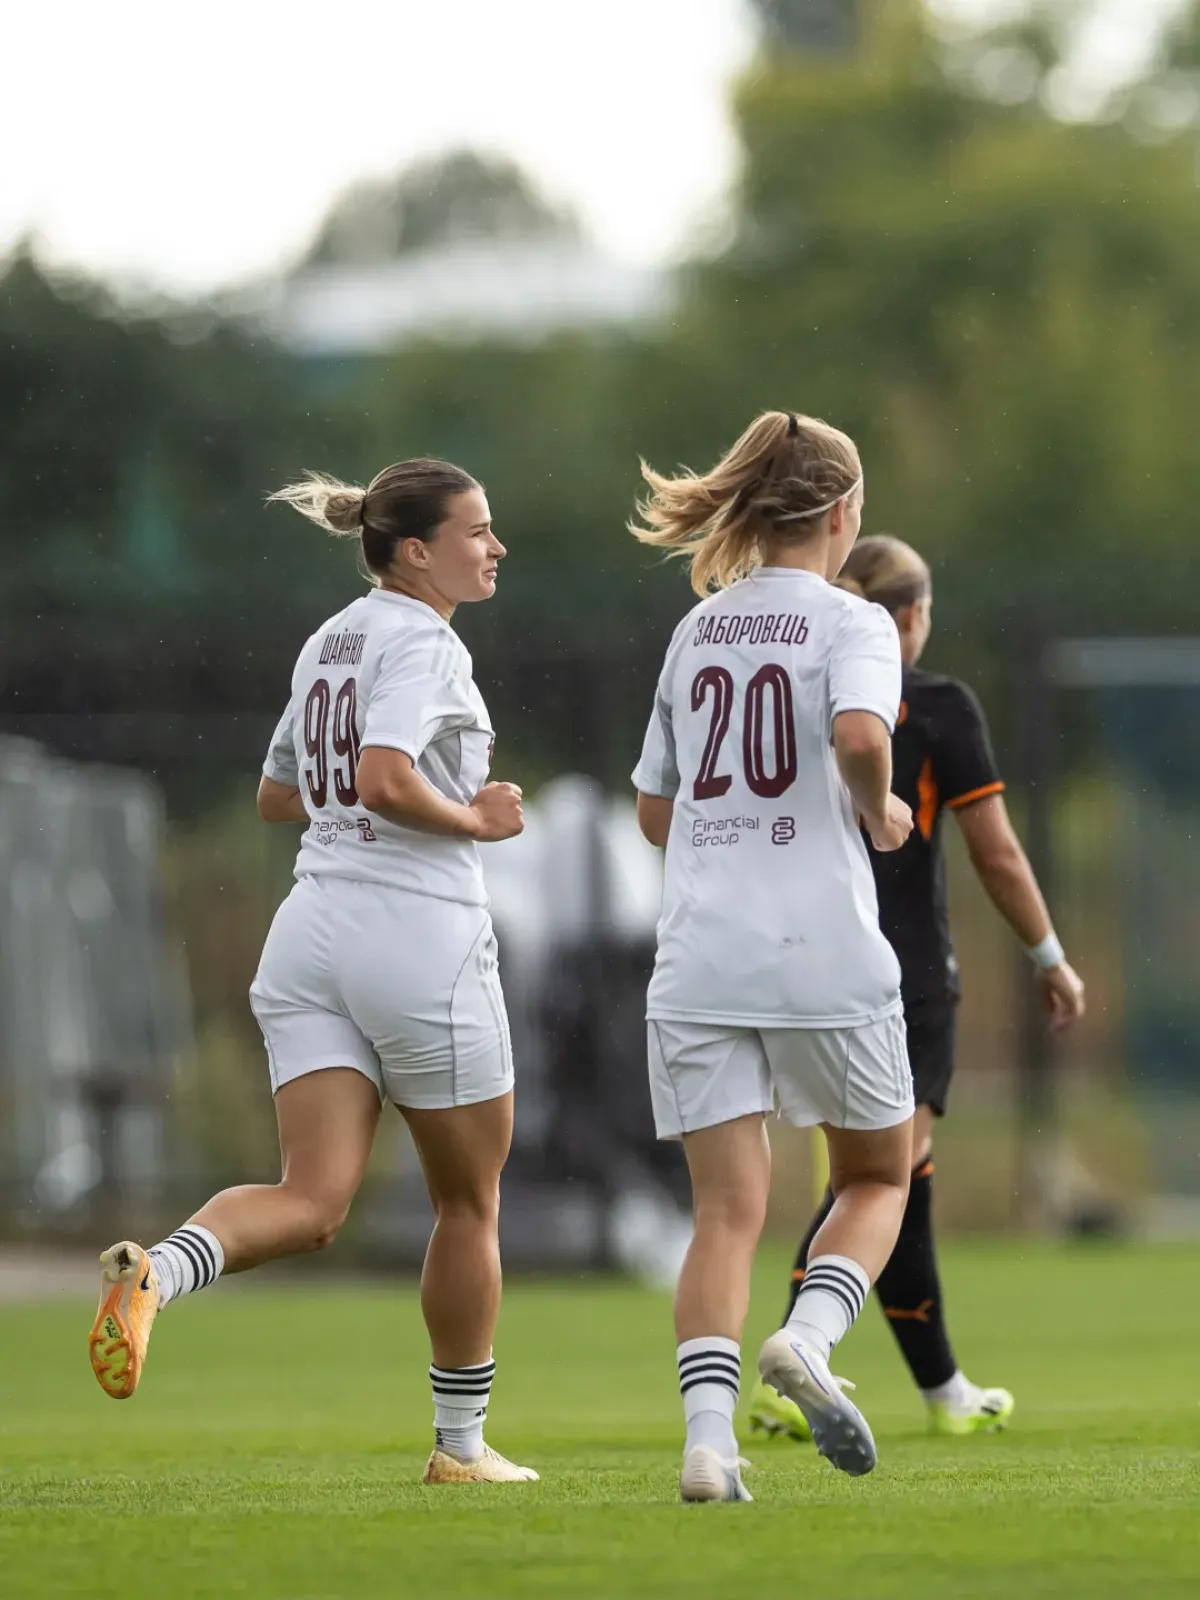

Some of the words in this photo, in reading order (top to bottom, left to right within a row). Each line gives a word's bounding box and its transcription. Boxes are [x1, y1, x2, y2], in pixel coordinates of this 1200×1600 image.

[693, 614, 809, 647] ЗАБОРОВЕЦЬ
[304, 677, 361, 809] 99
[691, 663, 797, 801] 20
[692, 816, 760, 833] Financial
[692, 832, 740, 847] Group
